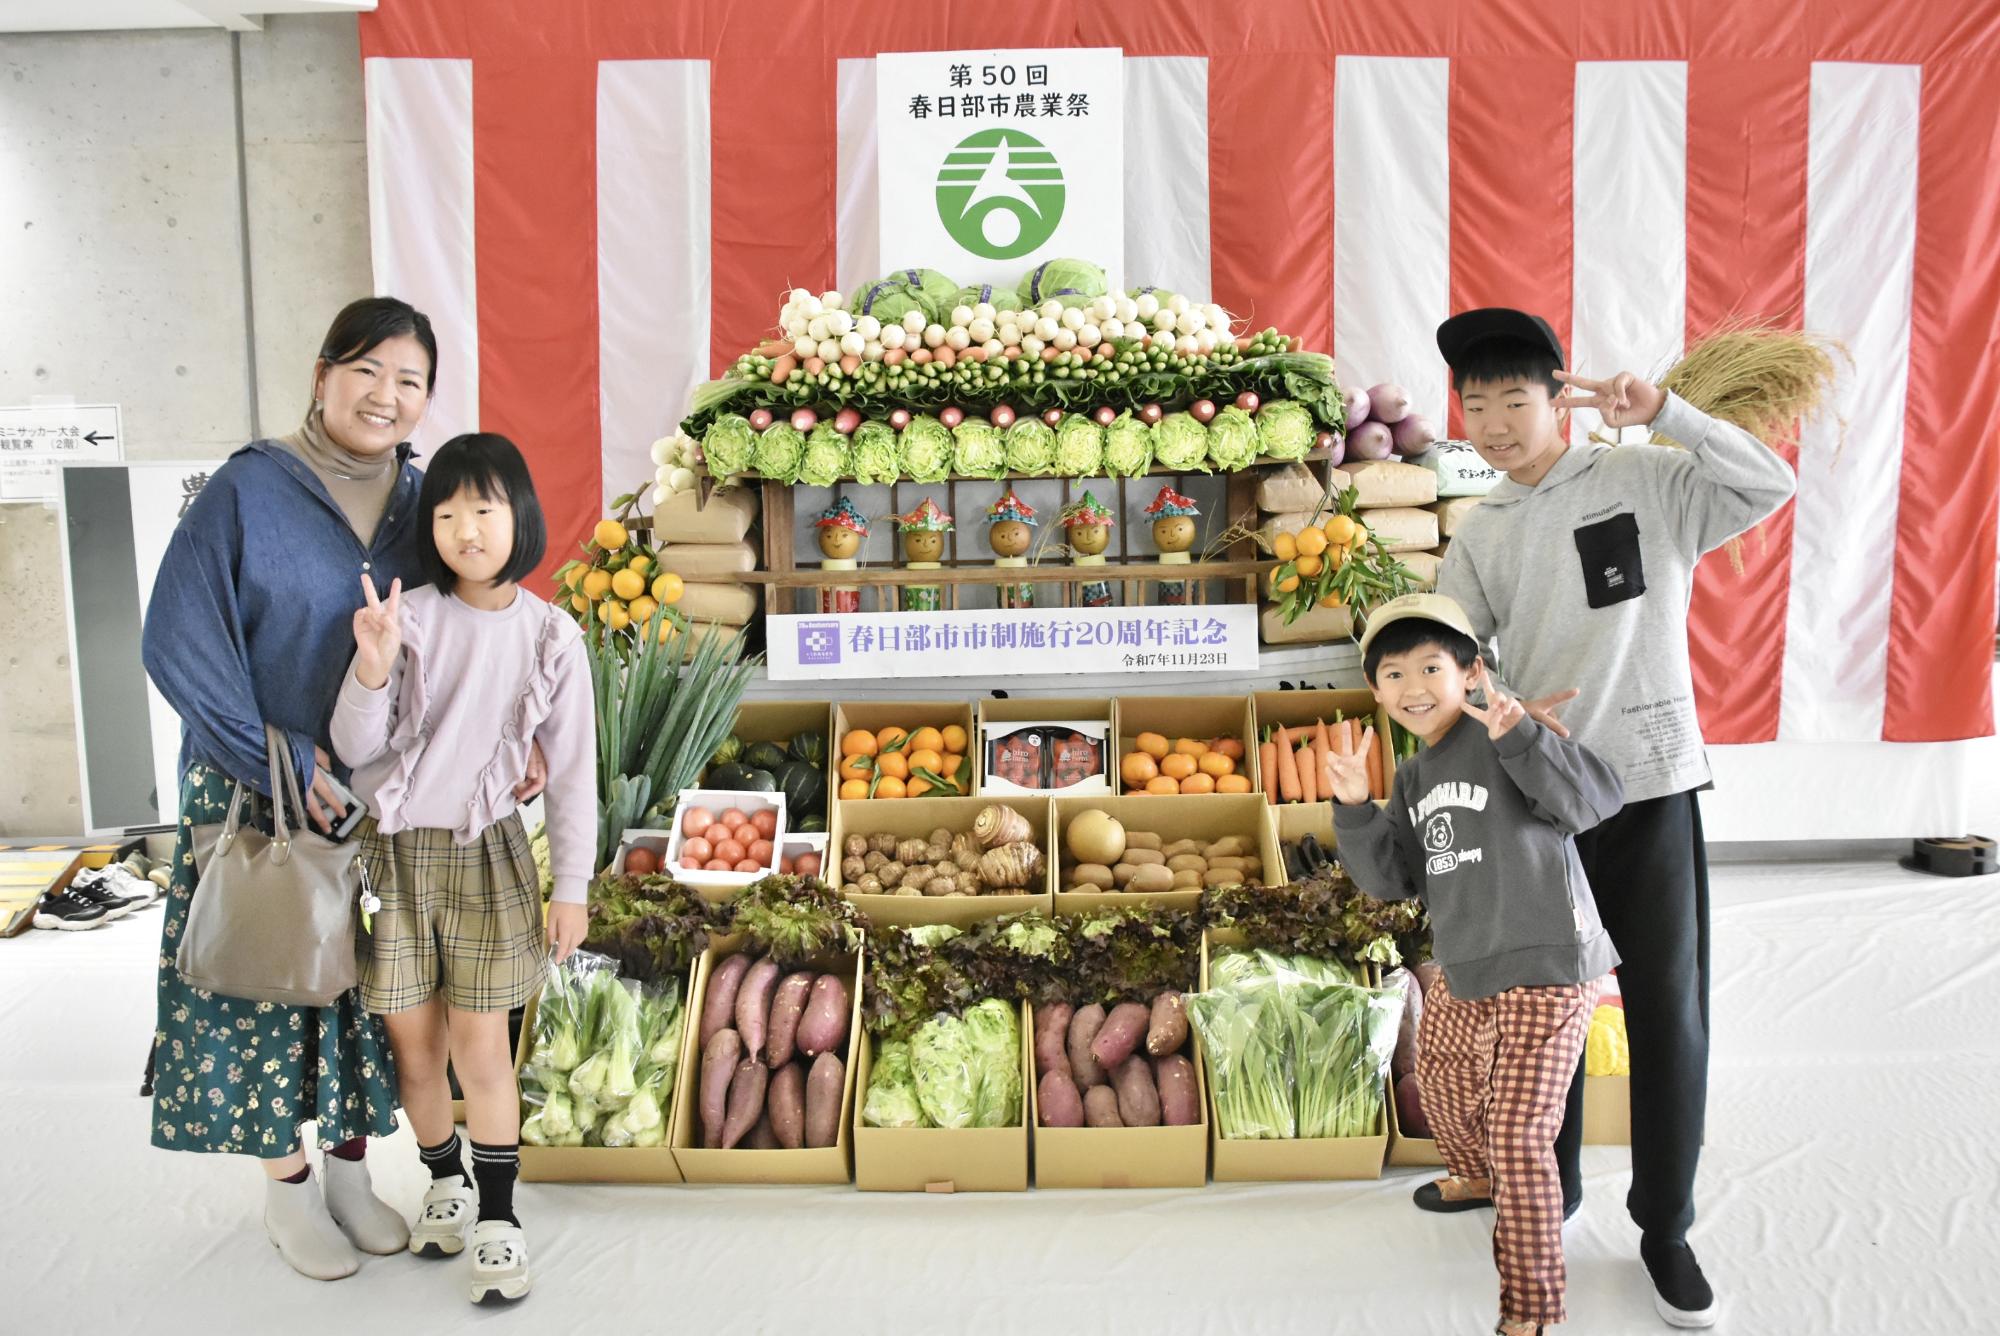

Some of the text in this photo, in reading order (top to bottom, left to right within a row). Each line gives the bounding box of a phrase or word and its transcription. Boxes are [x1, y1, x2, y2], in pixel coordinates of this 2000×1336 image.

[949, 63, 1048, 88] 第50回
[908, 92, 1091, 119] 春日部市農業祭
[0, 425, 80, 437] ミニサッカー大会
[1582, 501, 1623, 521] stimulation
[848, 617, 1228, 653] 春日部市市制施行20周年記念
[1122, 652, 1227, 667] 令和7年11月23日
[1621, 698, 1671, 715] Fashionable
[1432, 855, 1454, 872] 1853
